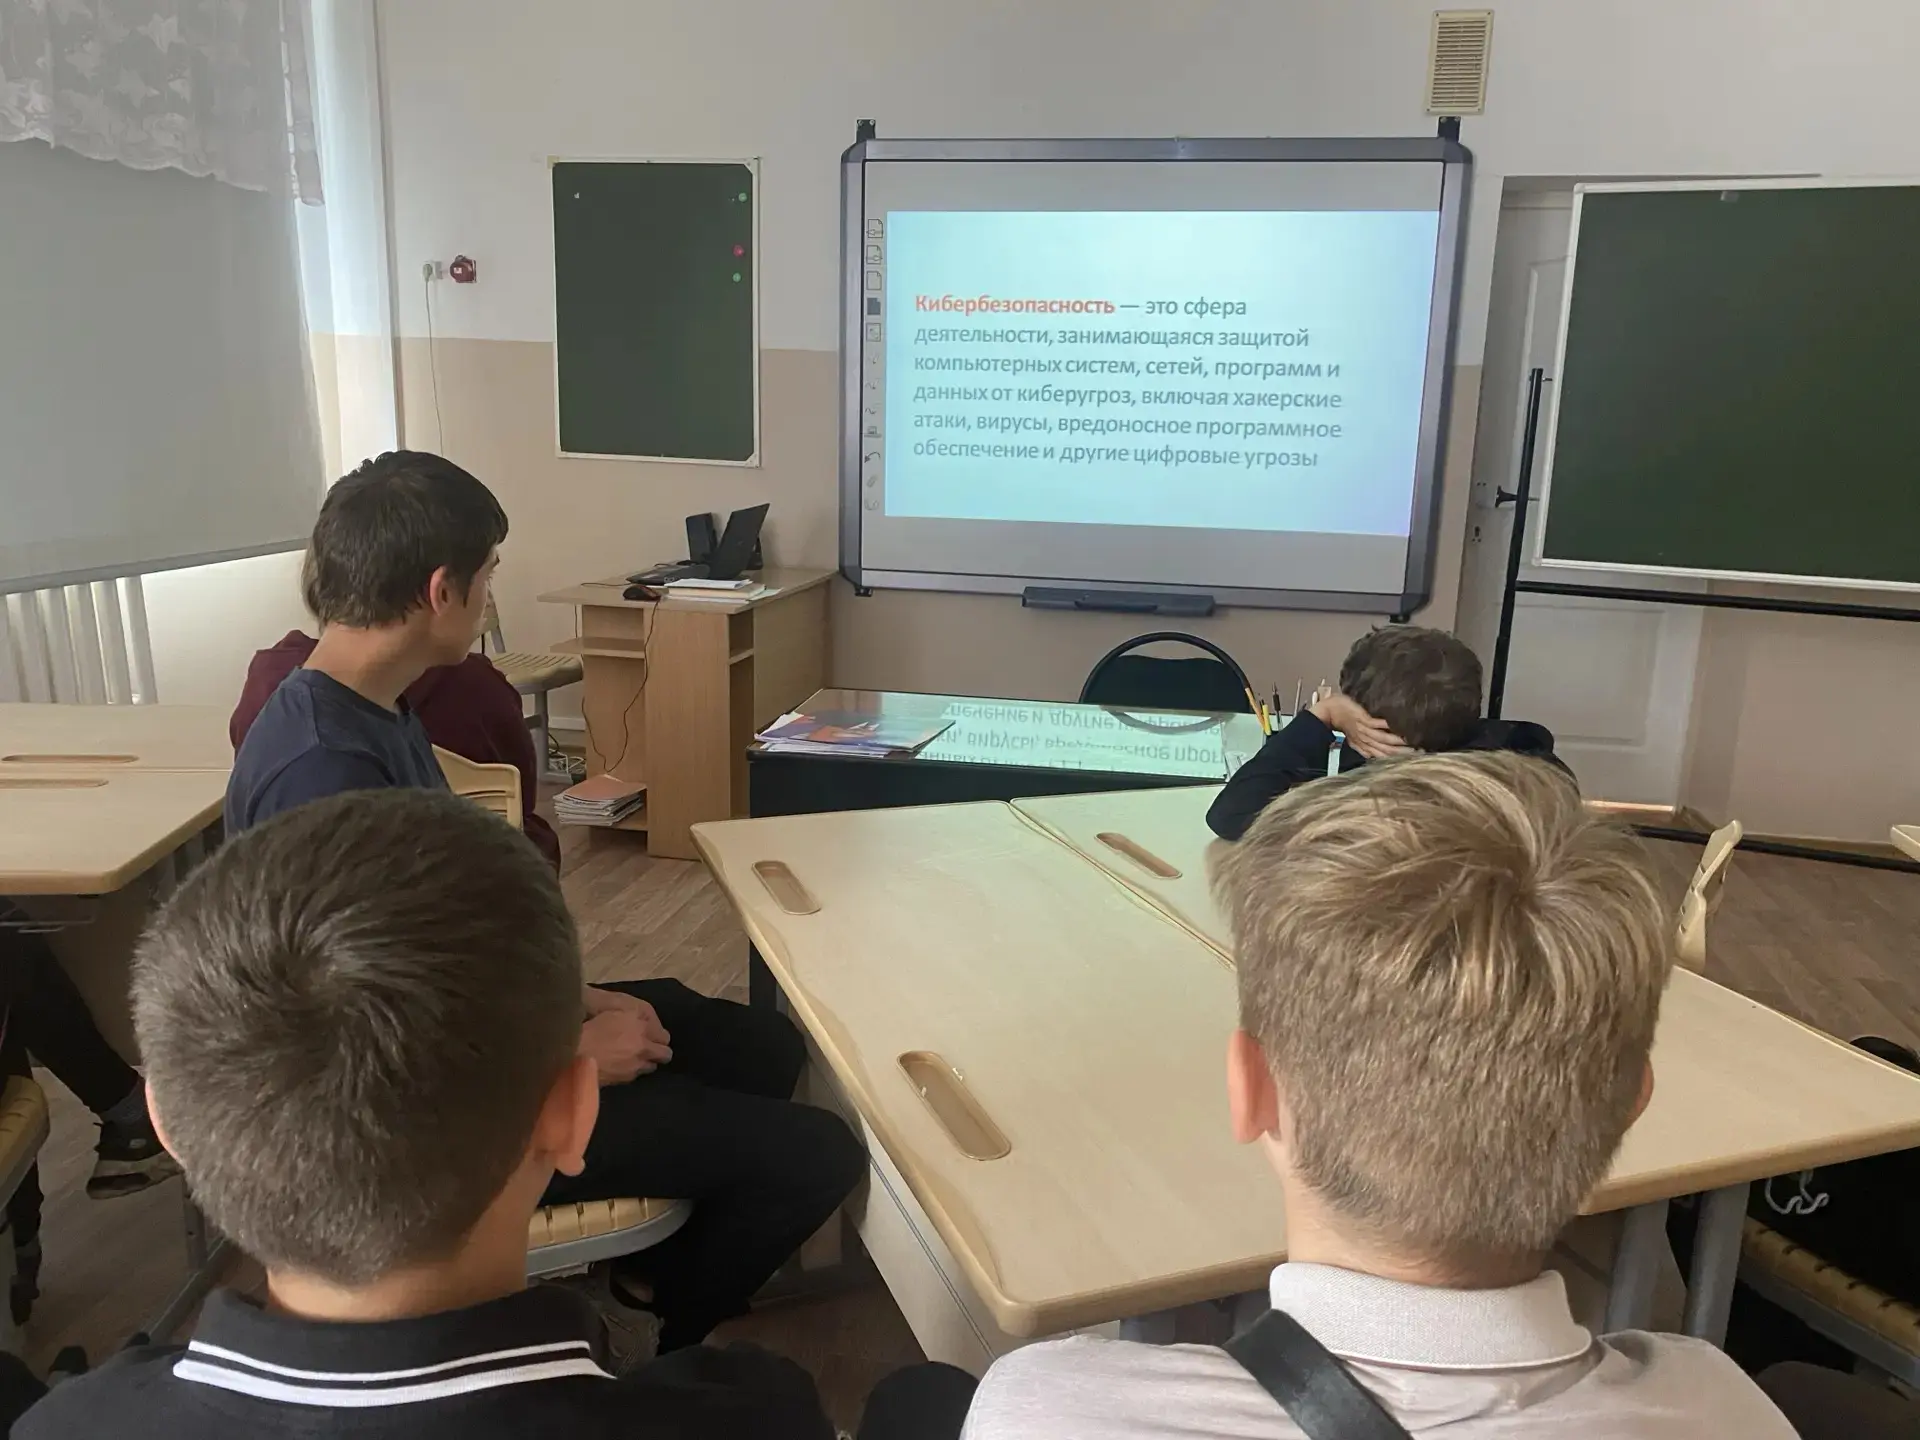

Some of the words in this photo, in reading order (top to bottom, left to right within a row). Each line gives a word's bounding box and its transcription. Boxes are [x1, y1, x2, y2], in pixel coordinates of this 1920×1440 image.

[915, 295, 1116, 316] Кибербезопасность
[1145, 300, 1178, 315] это
[1183, 296, 1247, 319] сфера
[914, 327, 1053, 346] деятельности,
[1057, 329, 1213, 348] занимающаяся
[1217, 328, 1309, 349] защитой
[914, 356, 1063, 375] компьютерных
[1065, 359, 1140, 377] систем,
[1145, 356, 1209, 378] сетей,
[1214, 361, 1322, 380] программ
[1327, 363, 1340, 377] и
[913, 385, 988, 402] данных
[991, 387, 1012, 401] от
[1017, 384, 1136, 407] киберугроз,
[1141, 389, 1228, 406] включая
[1232, 391, 1342, 410] хакерские
[914, 413, 972, 431] атаки,
[976, 415, 1053, 434] вирусы,
[1058, 417, 1192, 435] вредоносное
[1196, 420, 1342, 439] программное
[913, 438, 1039, 458] обеспечение
[1043, 445, 1054, 459] и
[1059, 445, 1129, 464] другие
[1133, 444, 1240, 467] цифровые
[1244, 450, 1318, 470] угрозы
